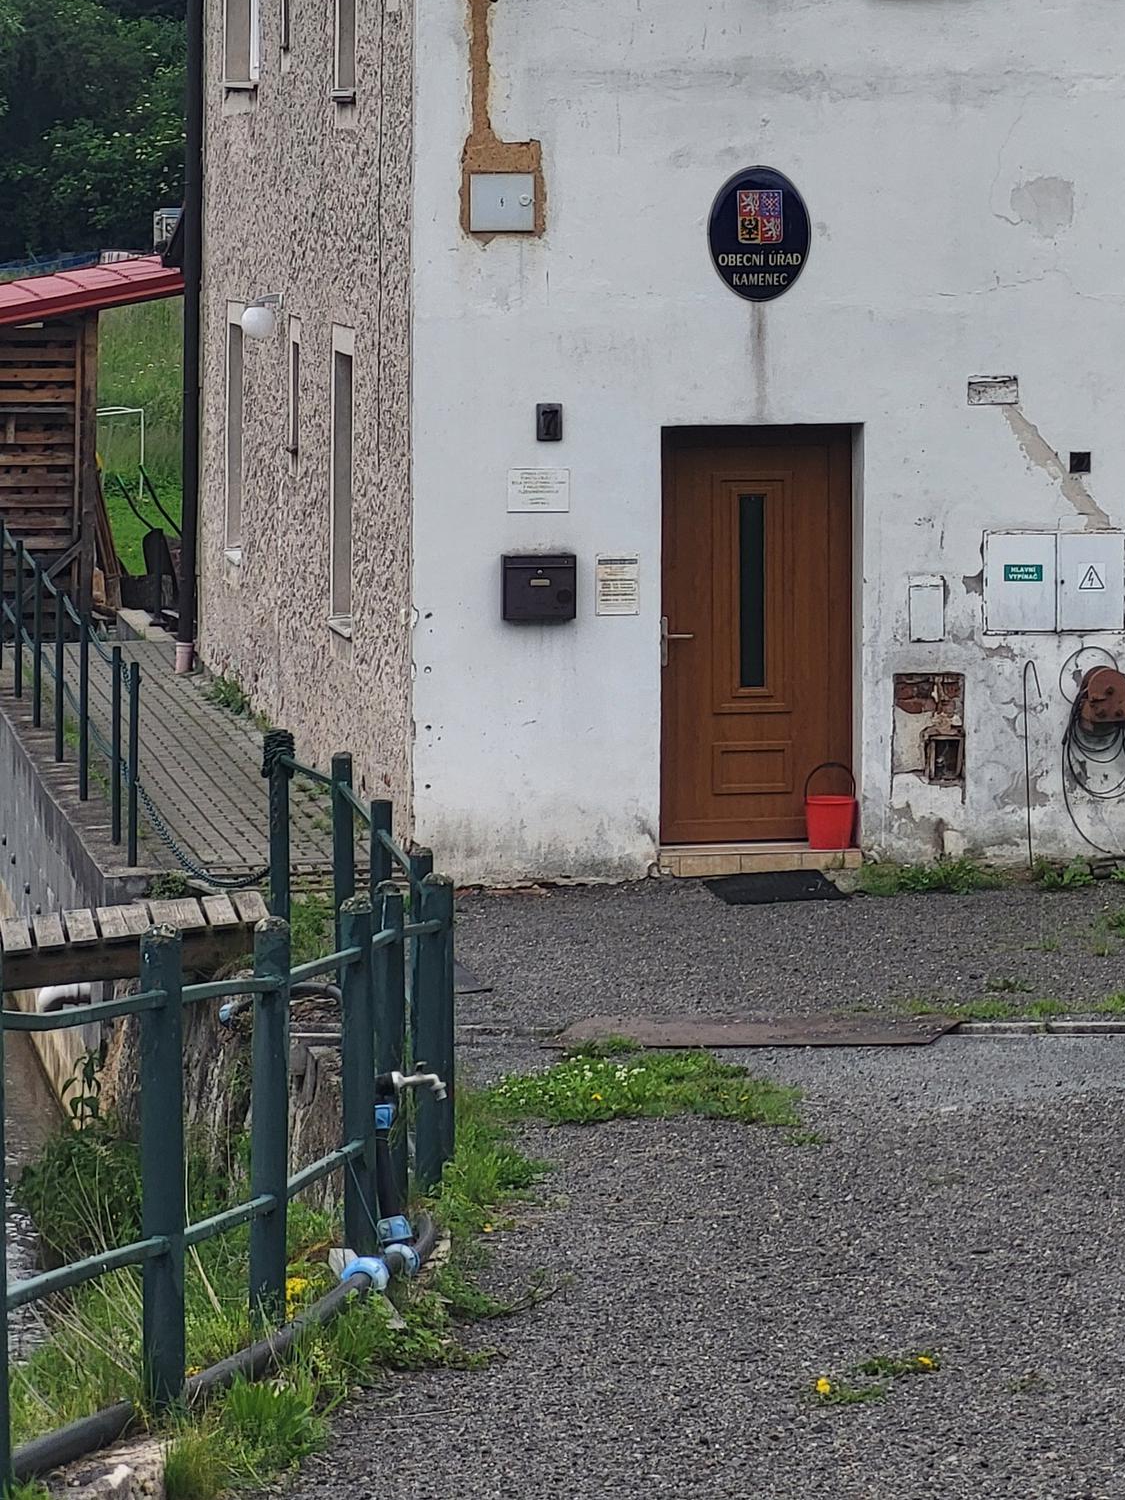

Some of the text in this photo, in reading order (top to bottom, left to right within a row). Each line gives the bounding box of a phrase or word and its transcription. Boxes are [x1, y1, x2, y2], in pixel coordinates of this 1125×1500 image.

[718, 250, 802, 266] OBECNÍ ÚŘAD
[732, 273, 788, 286] KAMENEC
[541, 409, 559, 436] 7
